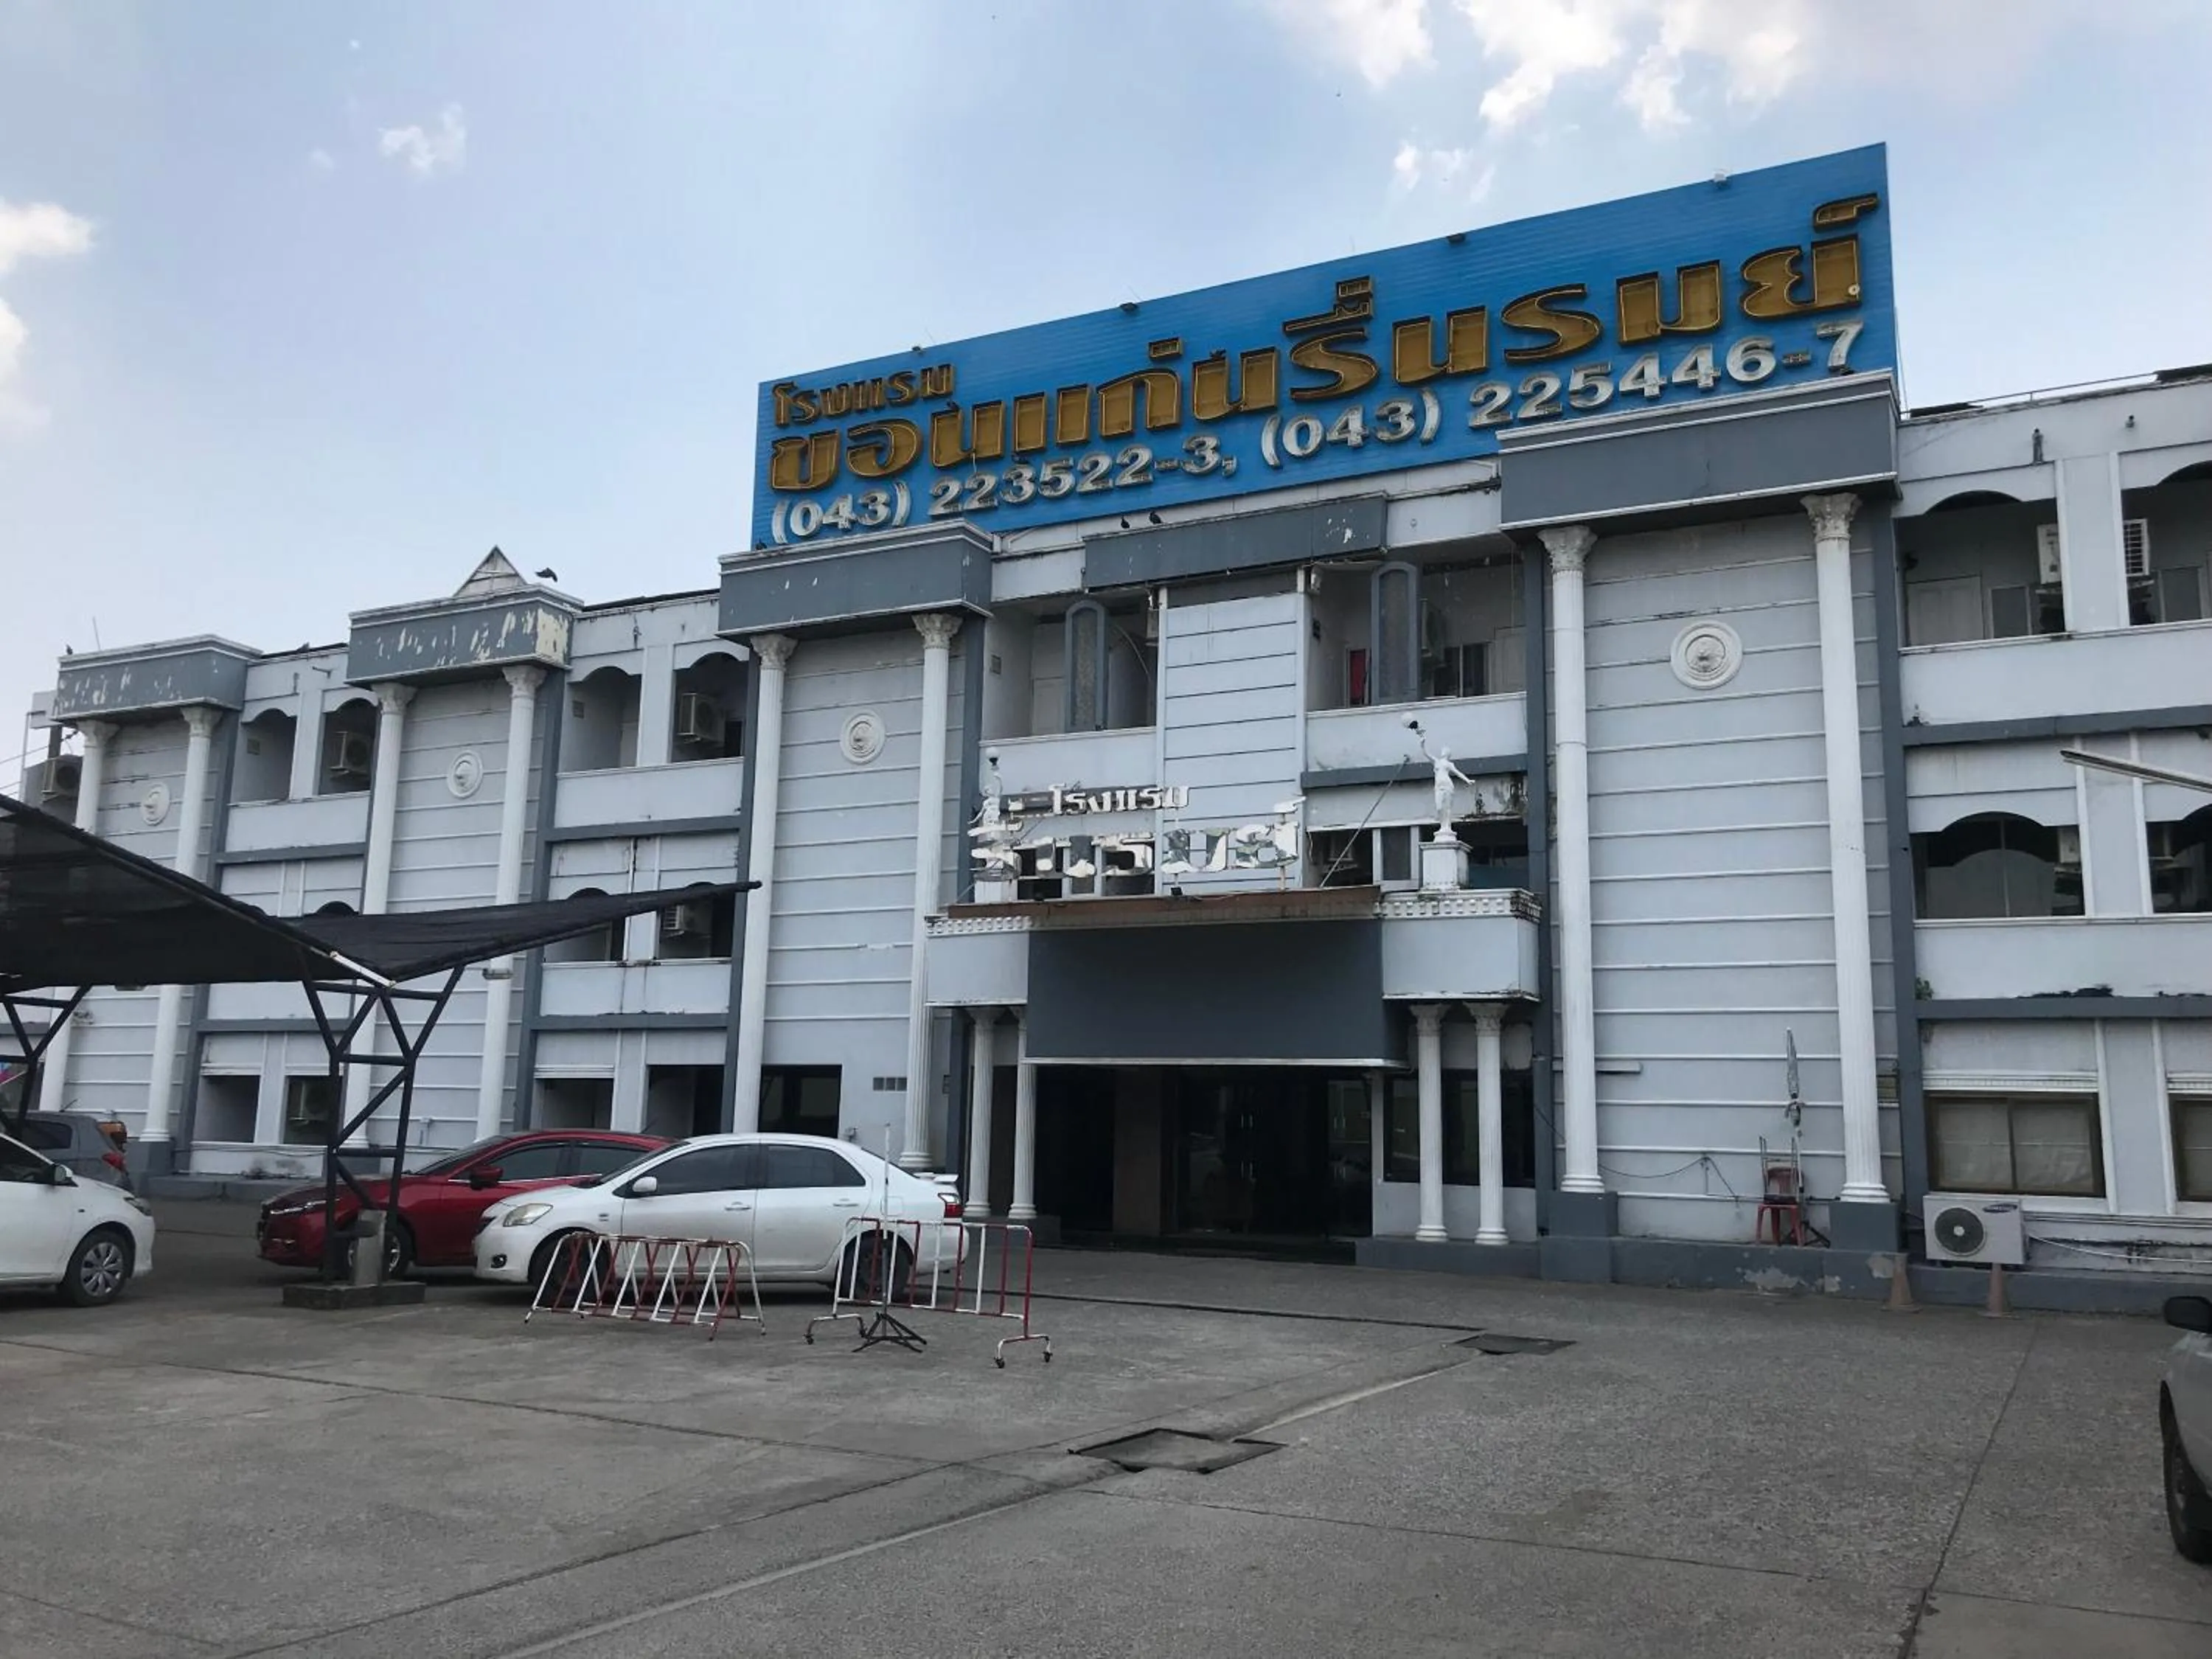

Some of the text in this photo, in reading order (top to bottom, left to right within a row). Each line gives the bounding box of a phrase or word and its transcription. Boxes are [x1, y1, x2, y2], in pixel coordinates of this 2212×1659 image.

[771, 193, 1879, 490] ขอนแก่นรื่นรมย์
[773, 364, 953, 426] โรงแรม
[773, 319, 1865, 544] (043) 223522-3, (043) 225446-7
[1048, 784, 1189, 815] โรงแรม
